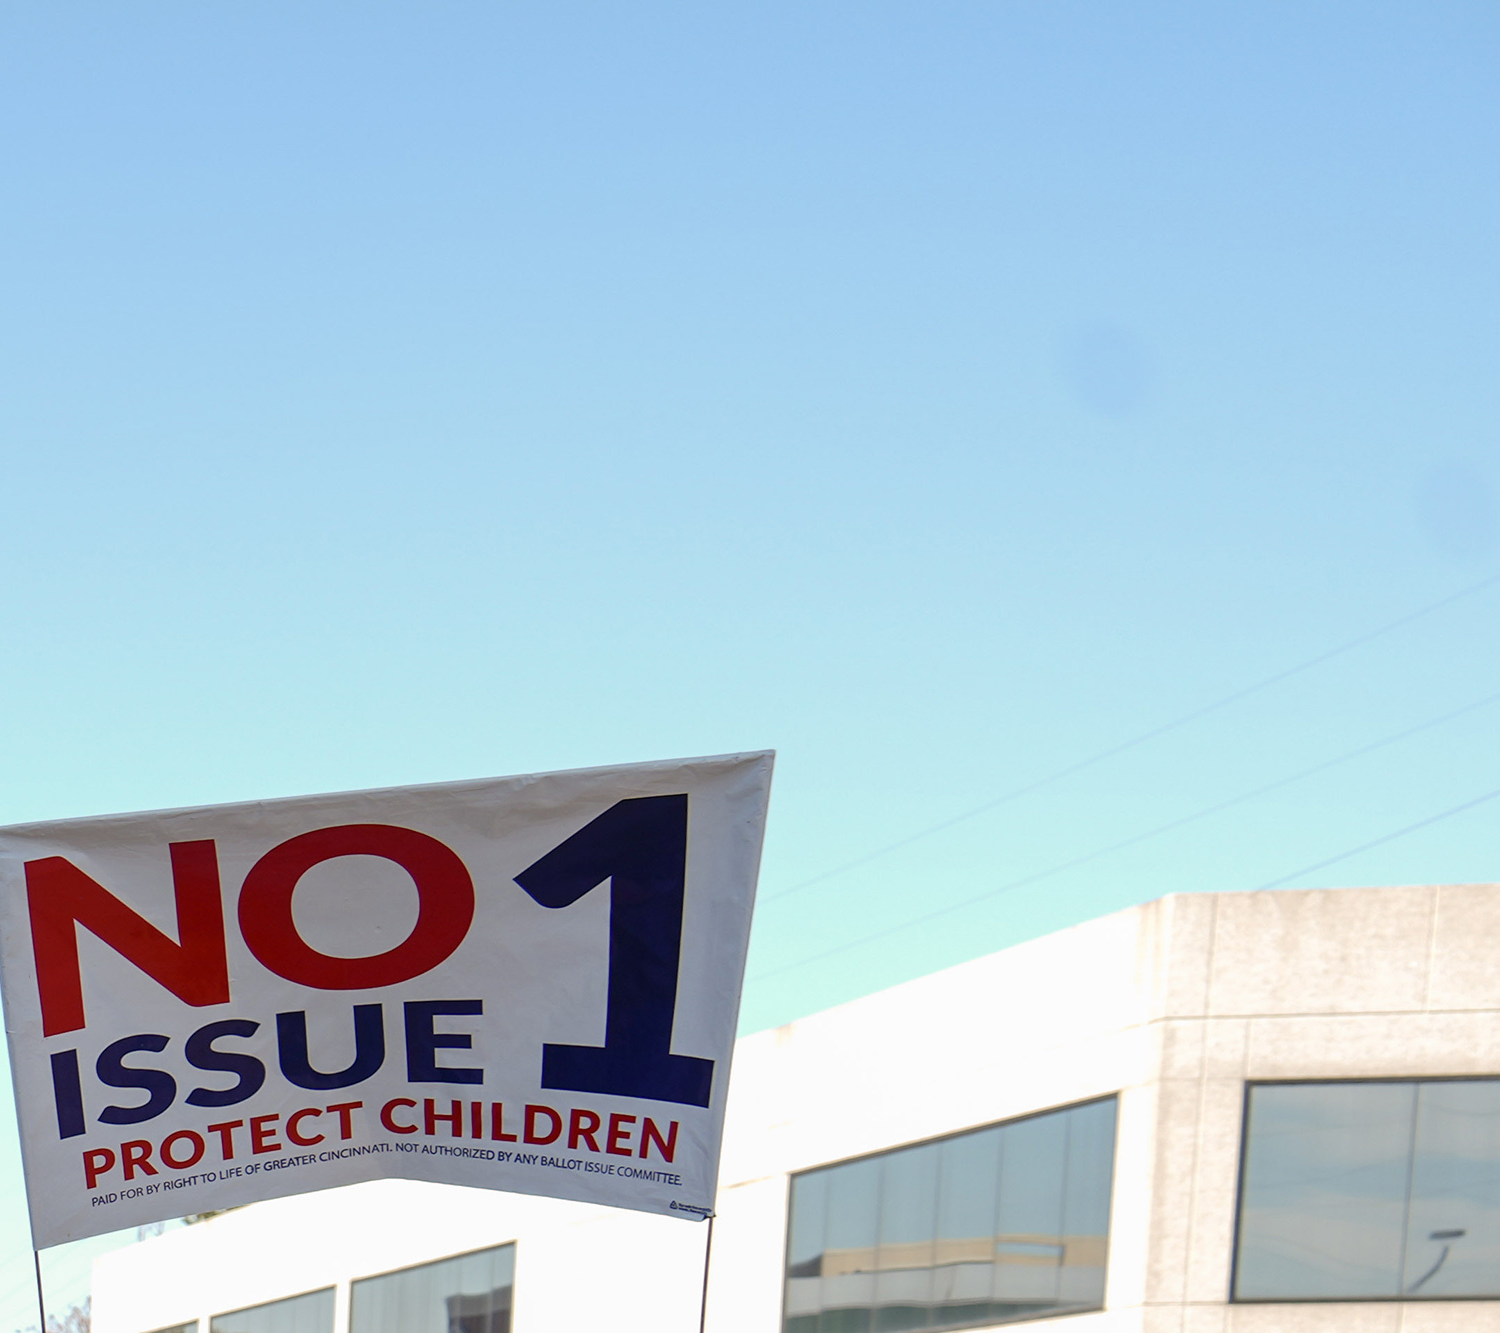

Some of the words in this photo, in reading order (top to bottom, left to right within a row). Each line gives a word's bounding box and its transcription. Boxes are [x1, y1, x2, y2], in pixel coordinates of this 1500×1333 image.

[23, 822, 476, 1038] NO
[513, 792, 716, 1109] 1
[49, 997, 486, 1141] ISSUE
[81, 1098, 364, 1191] PROTECT
[379, 1096, 681, 1165] CHILDREN
[91, 1193, 118, 1208] PAID
[120, 1187, 145, 1201] FOR
[145, 1182, 162, 1195] BY
[163, 1175, 200, 1191] RIGHT
[199, 1171, 217, 1184] TO
[219, 1167, 243, 1181] LIFE
[244, 1163, 261, 1175] OF
[263, 1154, 317, 1172] GREATER
[318, 1143, 393, 1164] CINCINNATI.
[395, 1142, 420, 1154] NOT
[421, 1145, 495, 1161] AUTHORIZED
[497, 1151, 513, 1162] BY
[514, 1153, 539, 1166] ANY
[541, 1156, 584, 1172] BALLOT
[584, 1161, 615, 1176] ISSUE
[616, 1165, 683, 1187] COMMITTEE.
